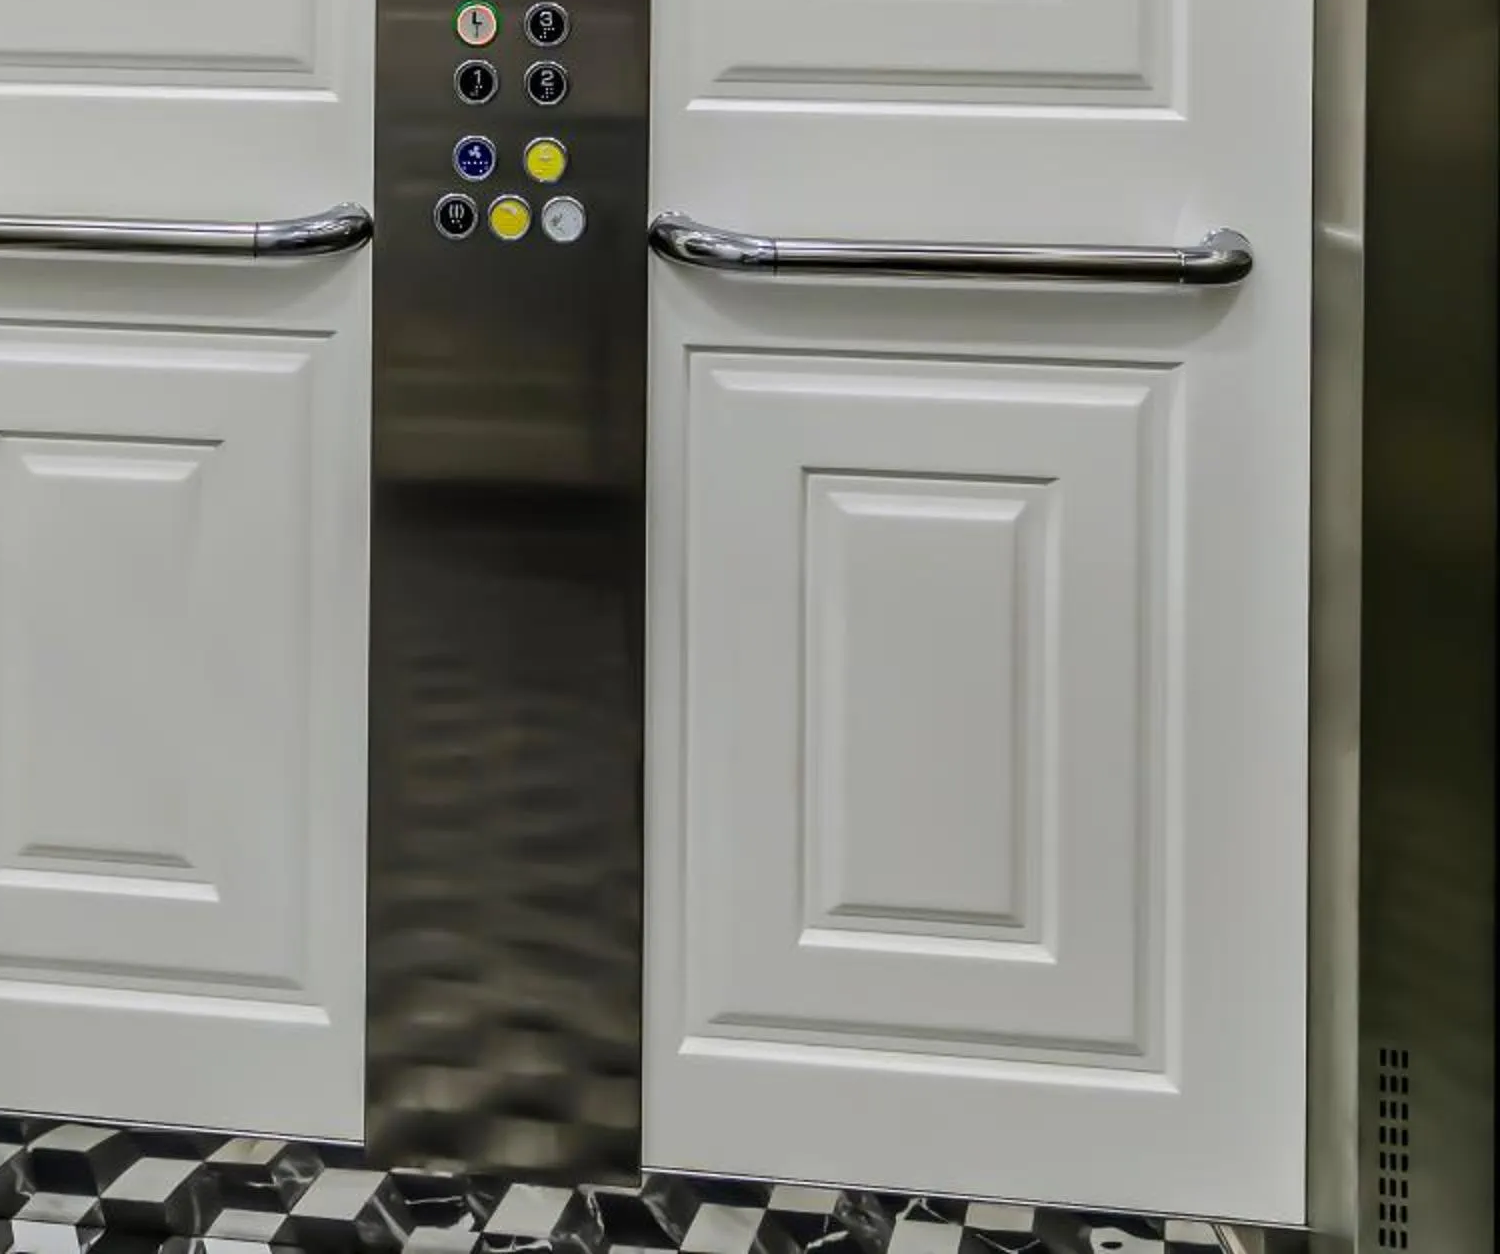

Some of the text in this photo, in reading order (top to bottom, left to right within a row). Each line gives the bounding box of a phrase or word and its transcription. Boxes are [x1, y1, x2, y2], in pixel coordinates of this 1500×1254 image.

[472, 11, 483, 25] L
[540, 11, 553, 27] 3
[474, 69, 482, 85] 1
[541, 69, 555, 86] 2
